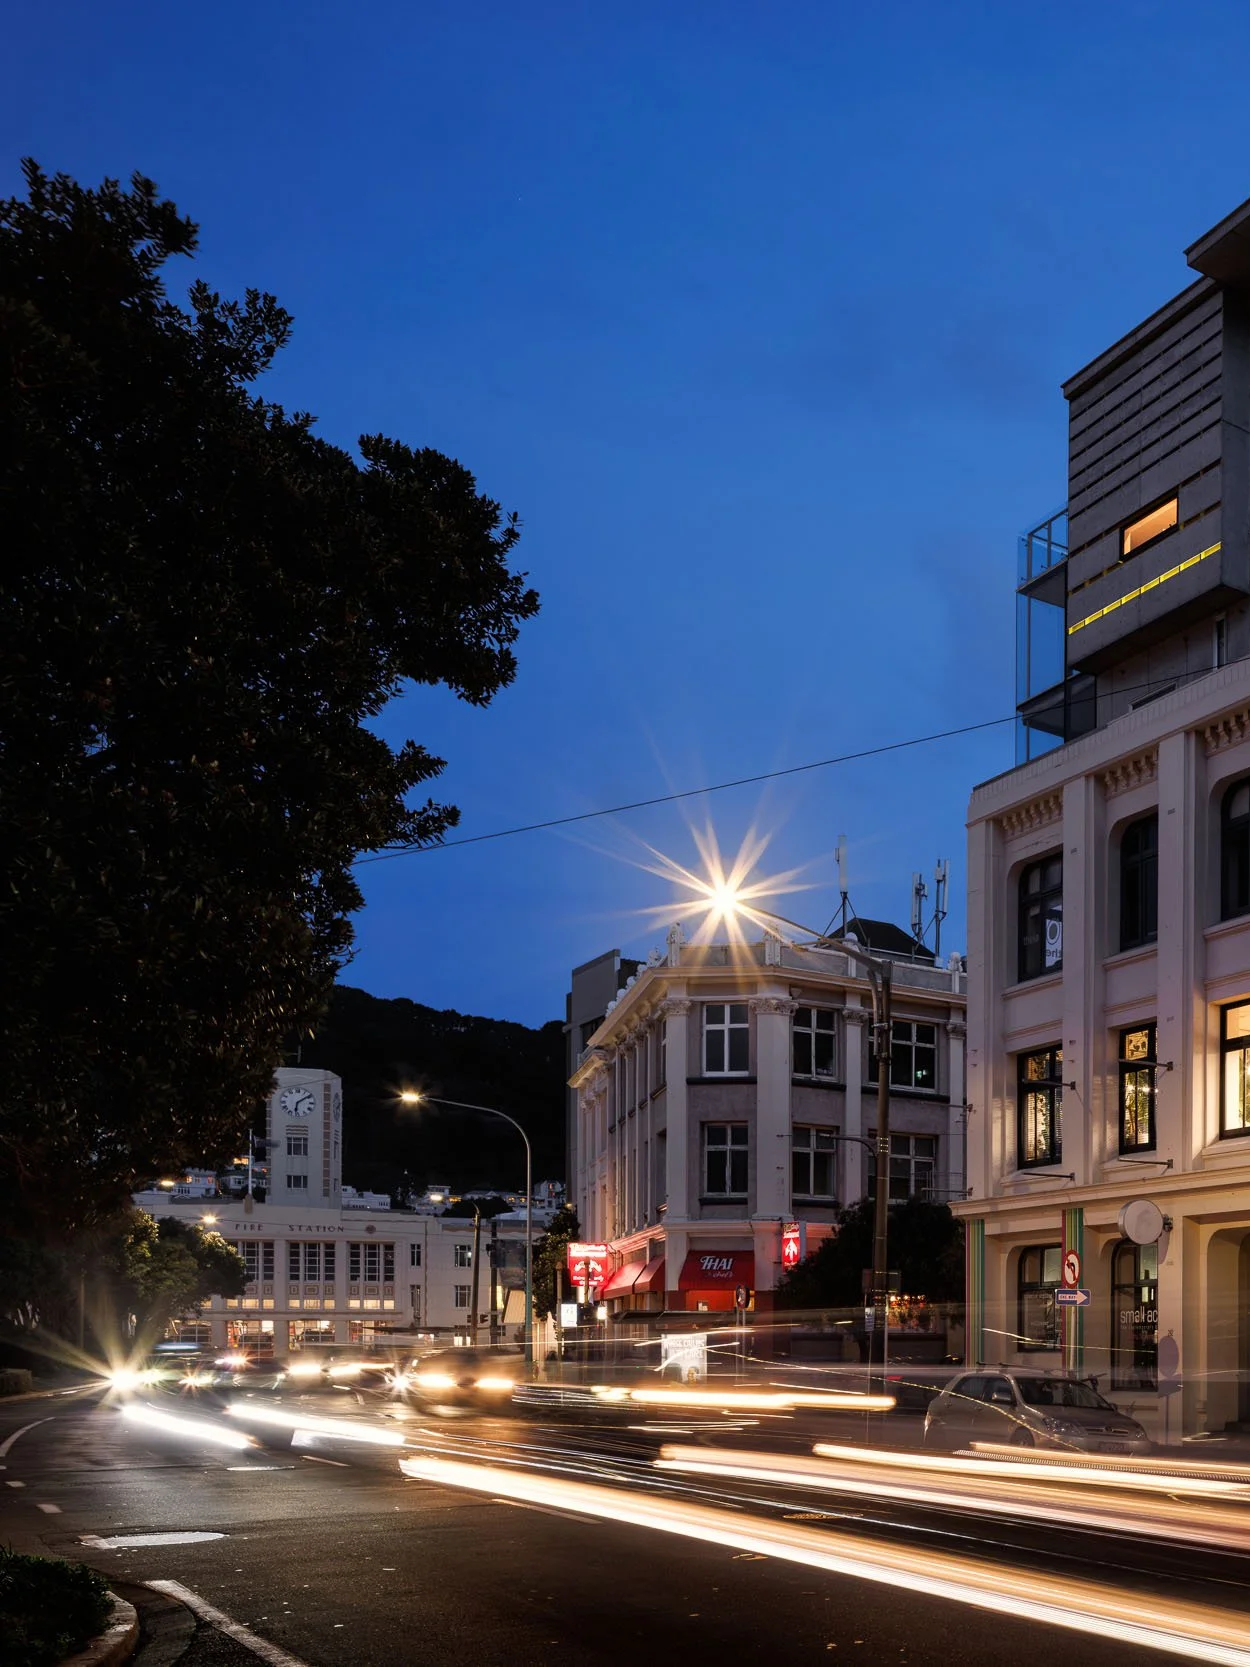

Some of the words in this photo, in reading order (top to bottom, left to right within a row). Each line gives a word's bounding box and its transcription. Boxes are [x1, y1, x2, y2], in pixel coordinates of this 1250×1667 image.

[235, 1223, 264, 1231] FIRE
[288, 1224, 345, 1233] STATION
[700, 1255, 734, 1270] THAI
